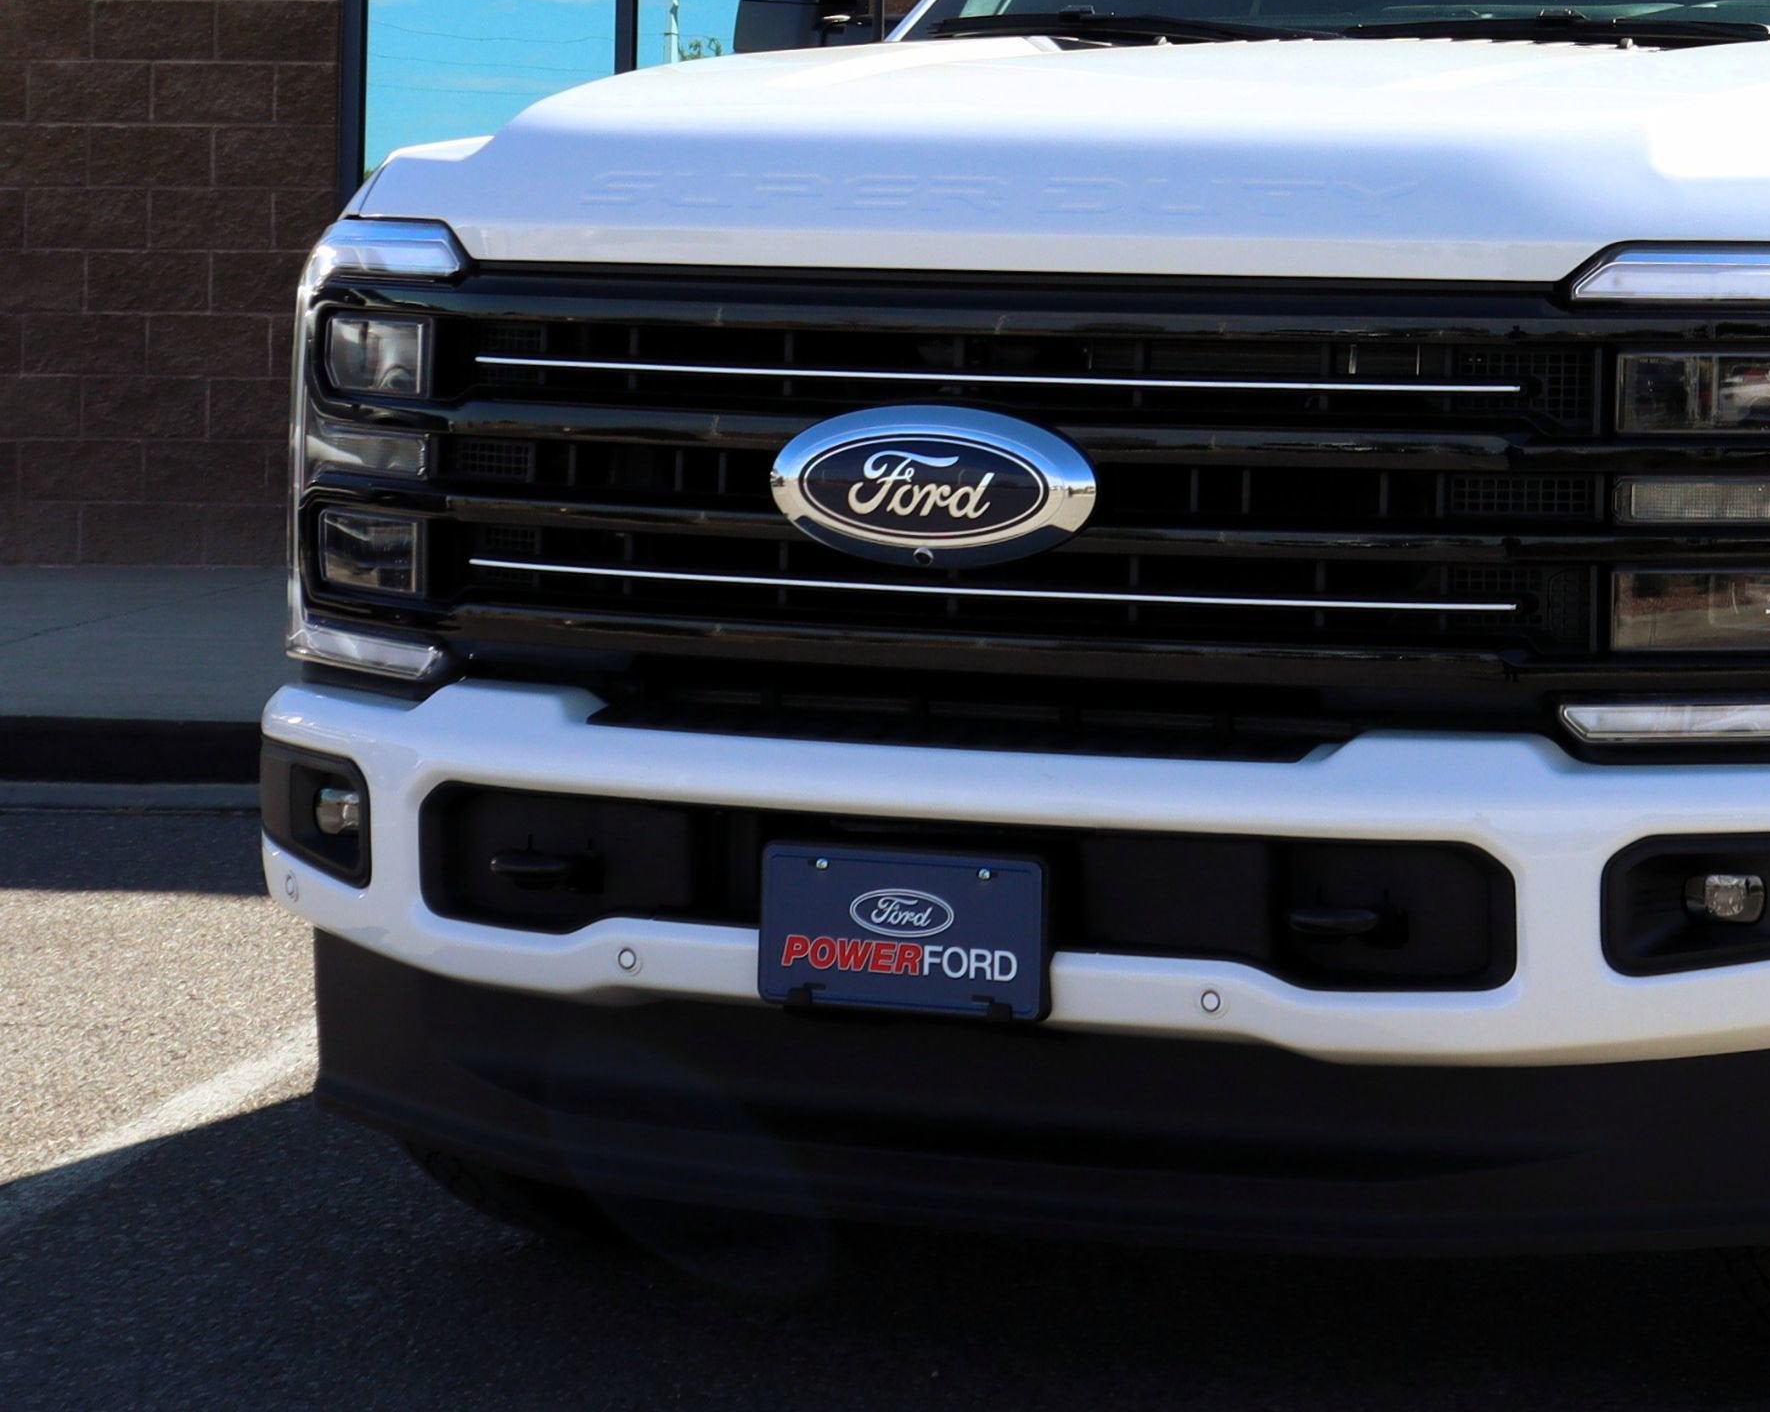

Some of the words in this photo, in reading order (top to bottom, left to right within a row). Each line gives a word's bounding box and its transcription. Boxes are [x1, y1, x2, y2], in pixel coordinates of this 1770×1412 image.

[579, 171, 1010, 212] SUPER
[1037, 175, 1420, 218] DUTY
[848, 450, 995, 519] Ford
[871, 896, 932, 928] Ford
